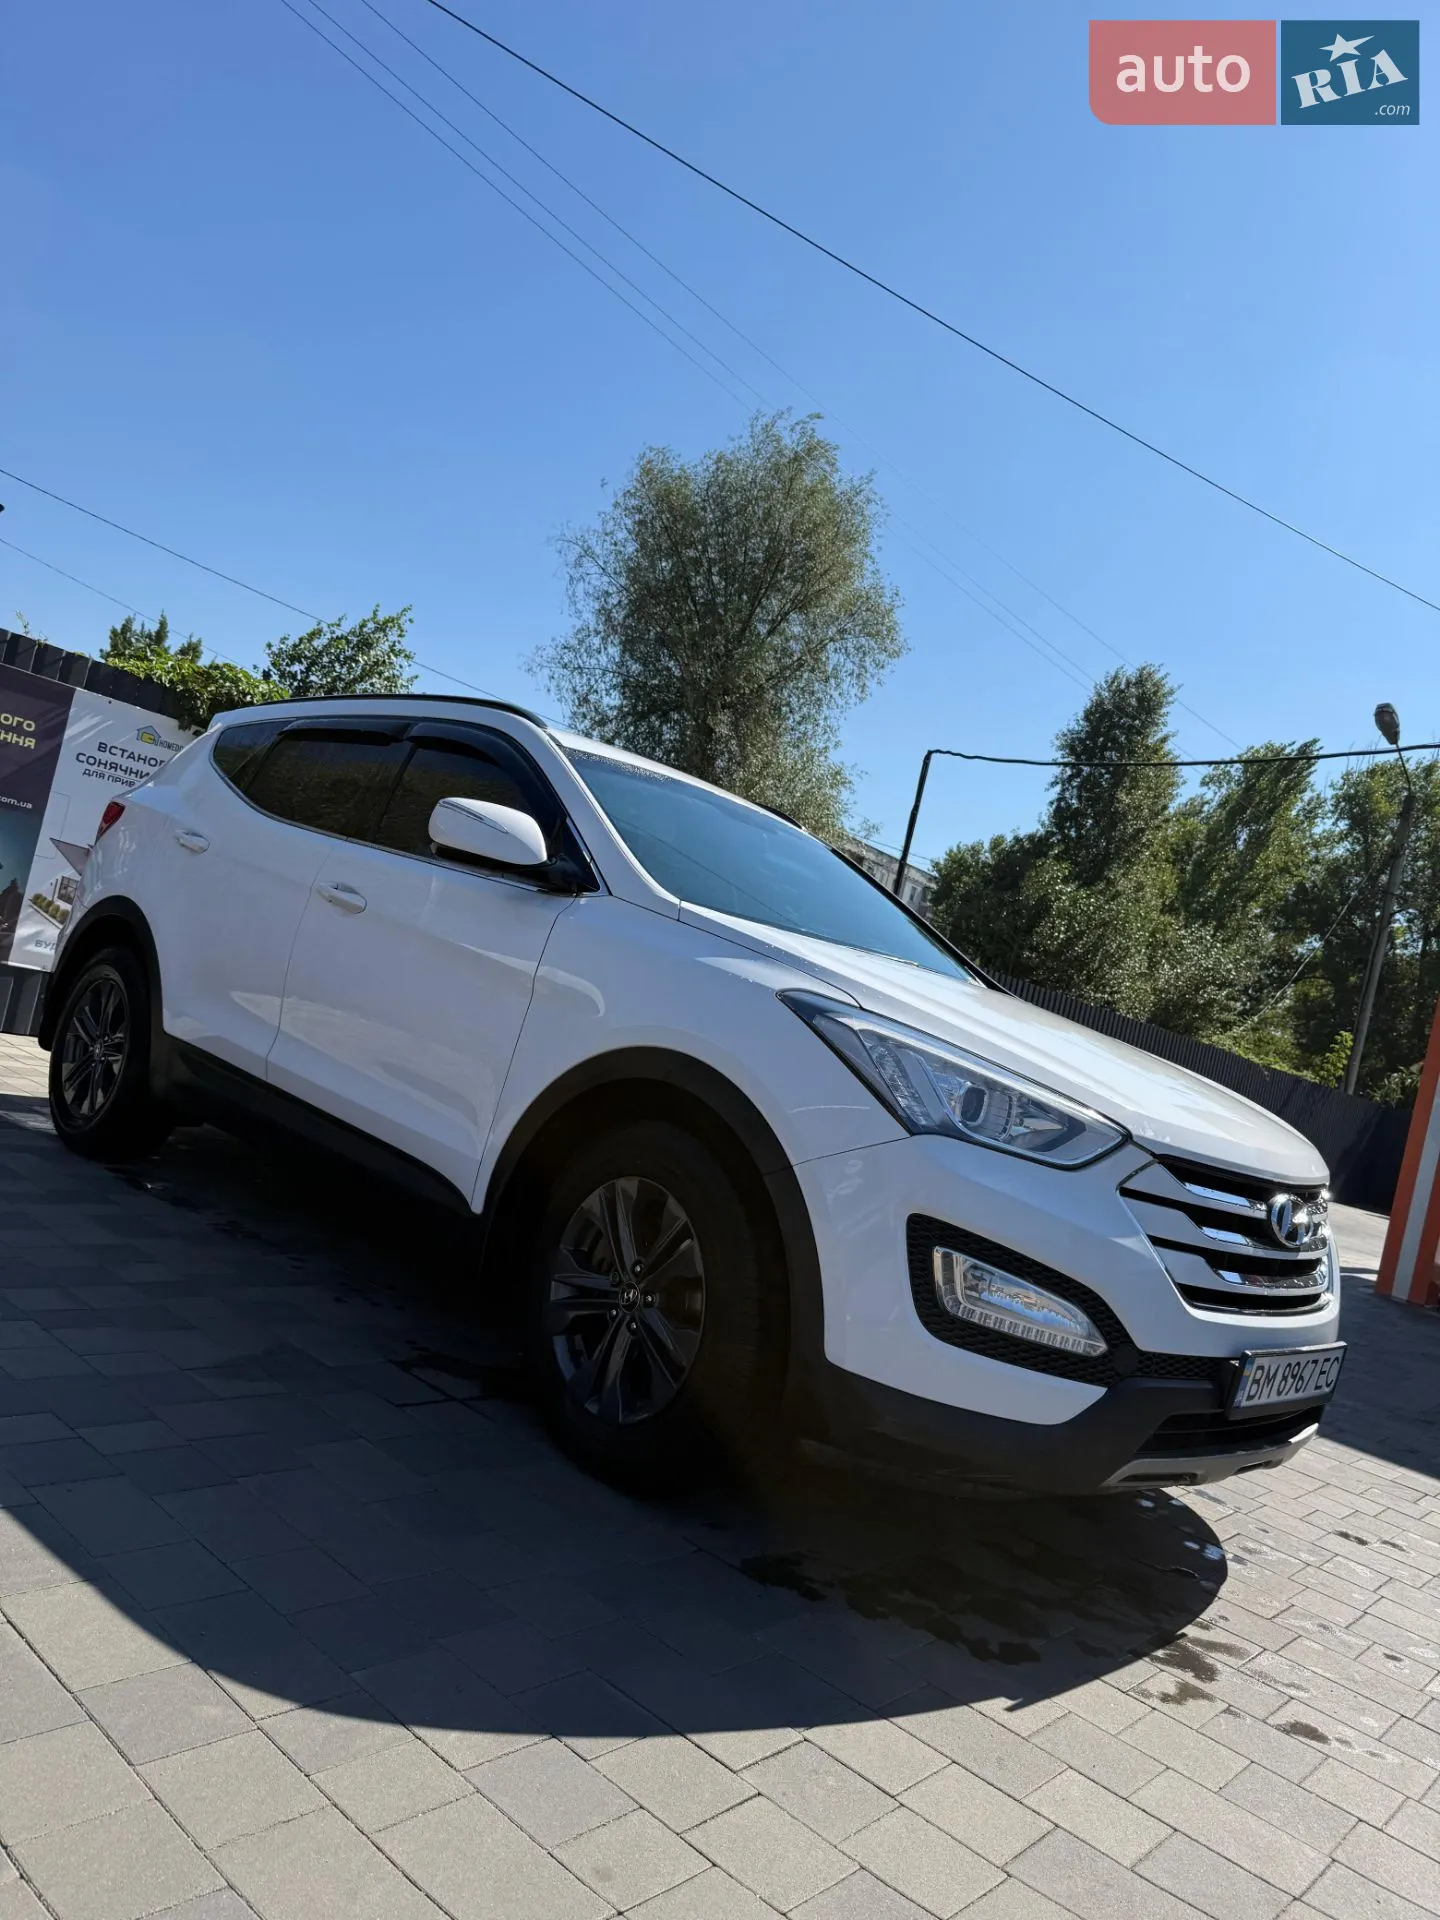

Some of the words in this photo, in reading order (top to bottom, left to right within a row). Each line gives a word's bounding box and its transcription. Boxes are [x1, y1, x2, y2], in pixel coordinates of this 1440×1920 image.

[0, 729, 36, 750] ННЯ
[1245, 1364, 1280, 1402] BM
[1276, 1359, 1318, 1397] 8967
[1314, 1356, 1340, 1391] EC
